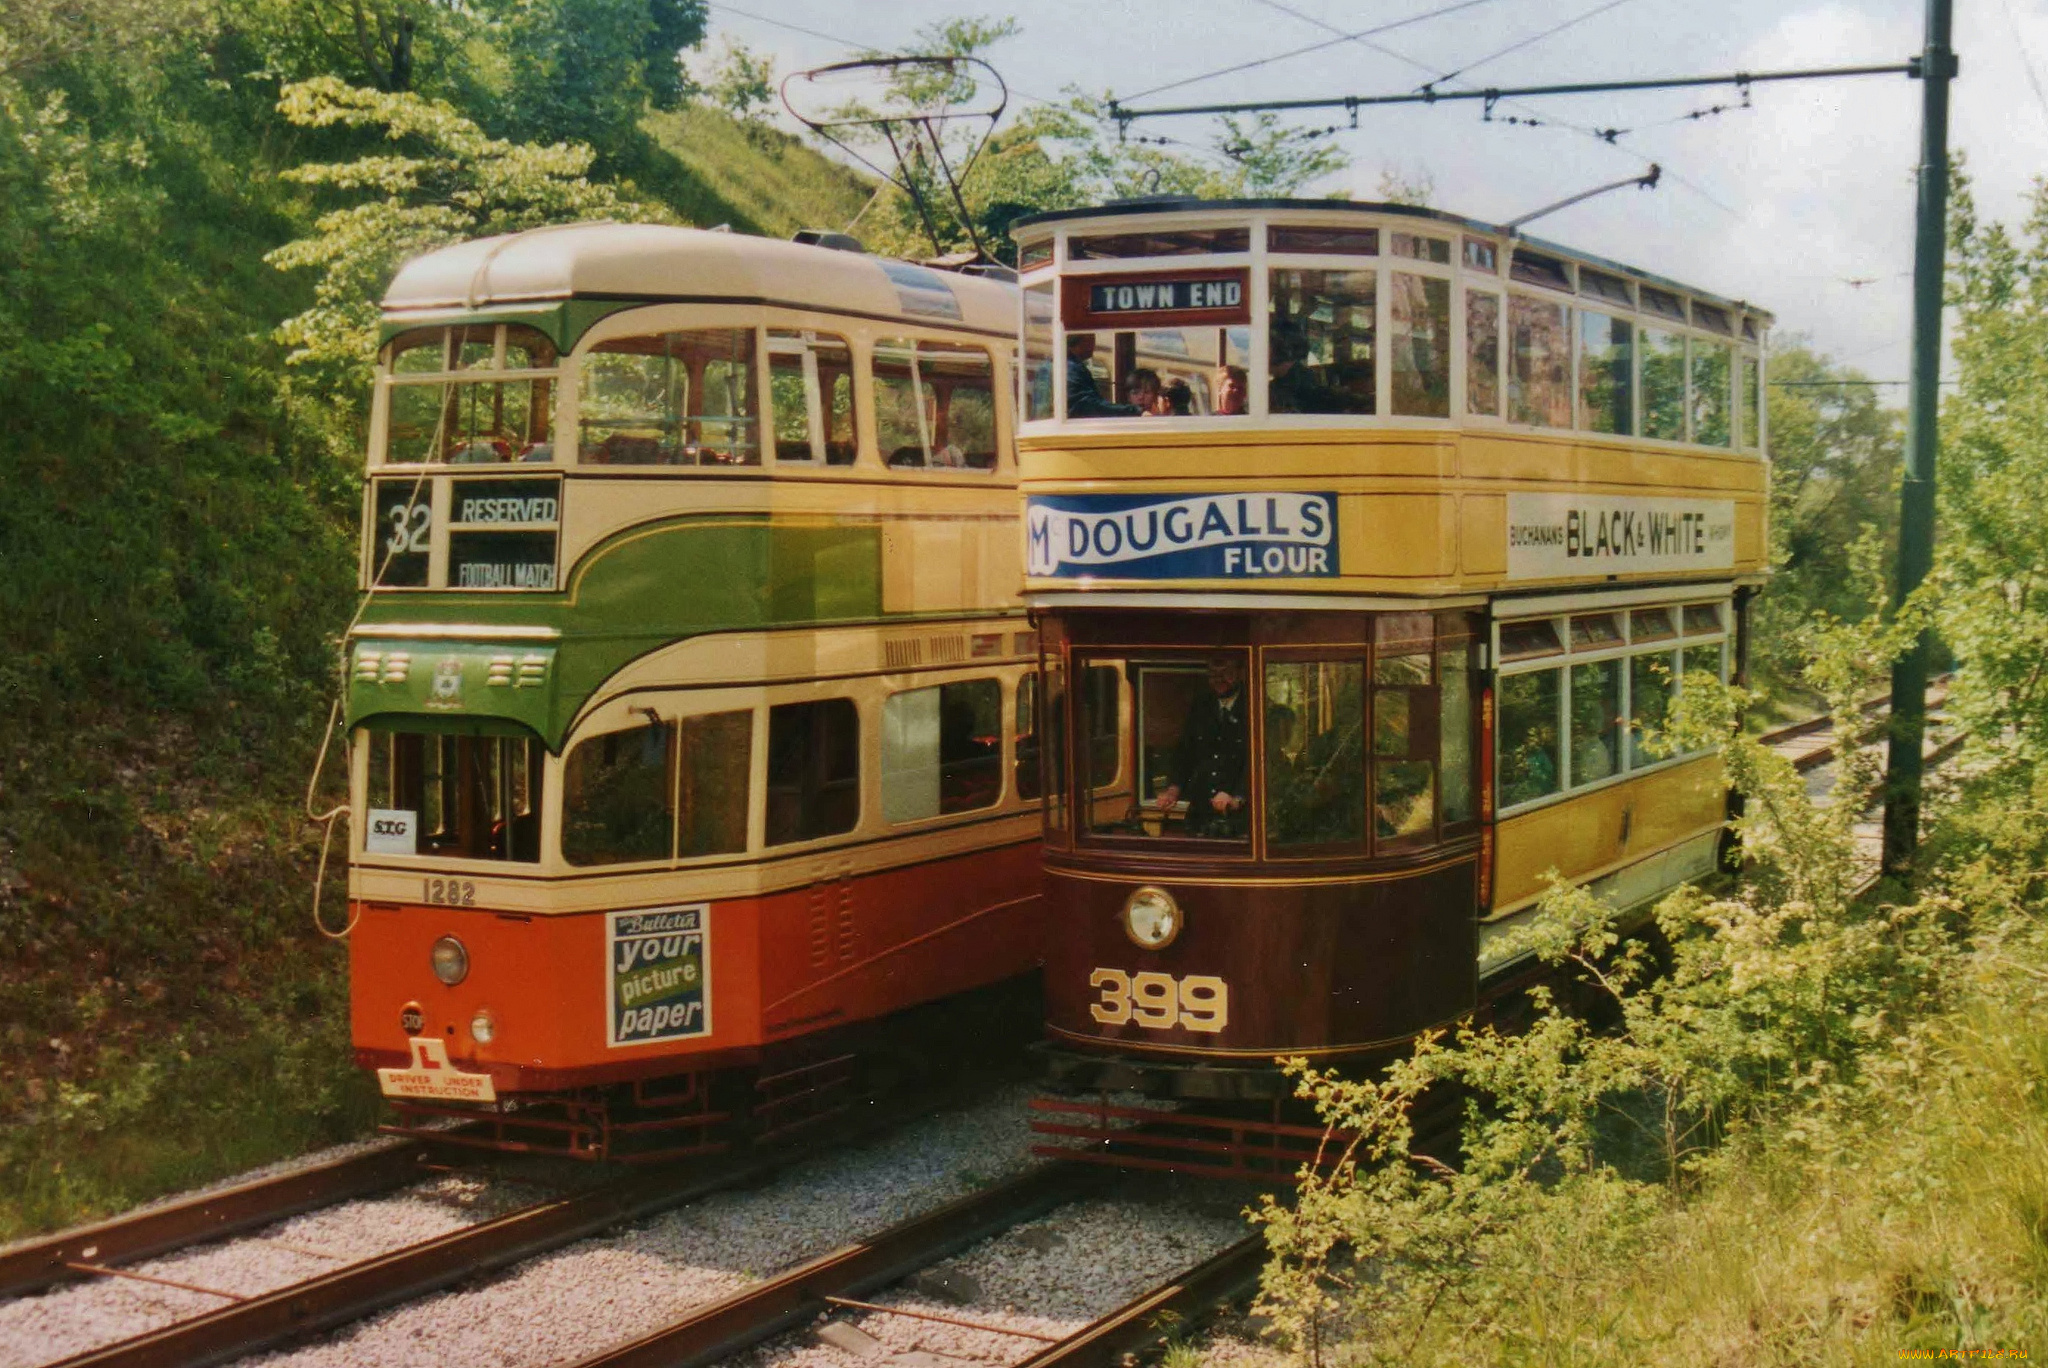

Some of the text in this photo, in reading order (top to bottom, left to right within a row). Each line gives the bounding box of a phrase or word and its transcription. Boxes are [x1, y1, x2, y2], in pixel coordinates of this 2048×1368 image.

[1103, 281, 1241, 310] TOWN END
[461, 498, 556, 523] RESERVED
[386, 504, 431, 553] 32
[1567, 510, 1636, 557] BLACK
[1648, 511, 1704, 555] WHITE
[1224, 547, 1329, 574] FLOUR
[459, 563, 555, 588] FOOTBALL MATCH
[423, 878, 475, 906] 1282
[626, 912, 696, 934] Bulletin
[616, 934, 700, 973] your
[621, 963, 697, 1006] picture
[1089, 967, 1228, 1033] 399
[618, 1001, 702, 1040] paper
[418, 1045, 441, 1069] L
[389, 1074, 483, 1087] DRIVER UNDER
[401, 1085, 479, 1097] INSTRUCTION
